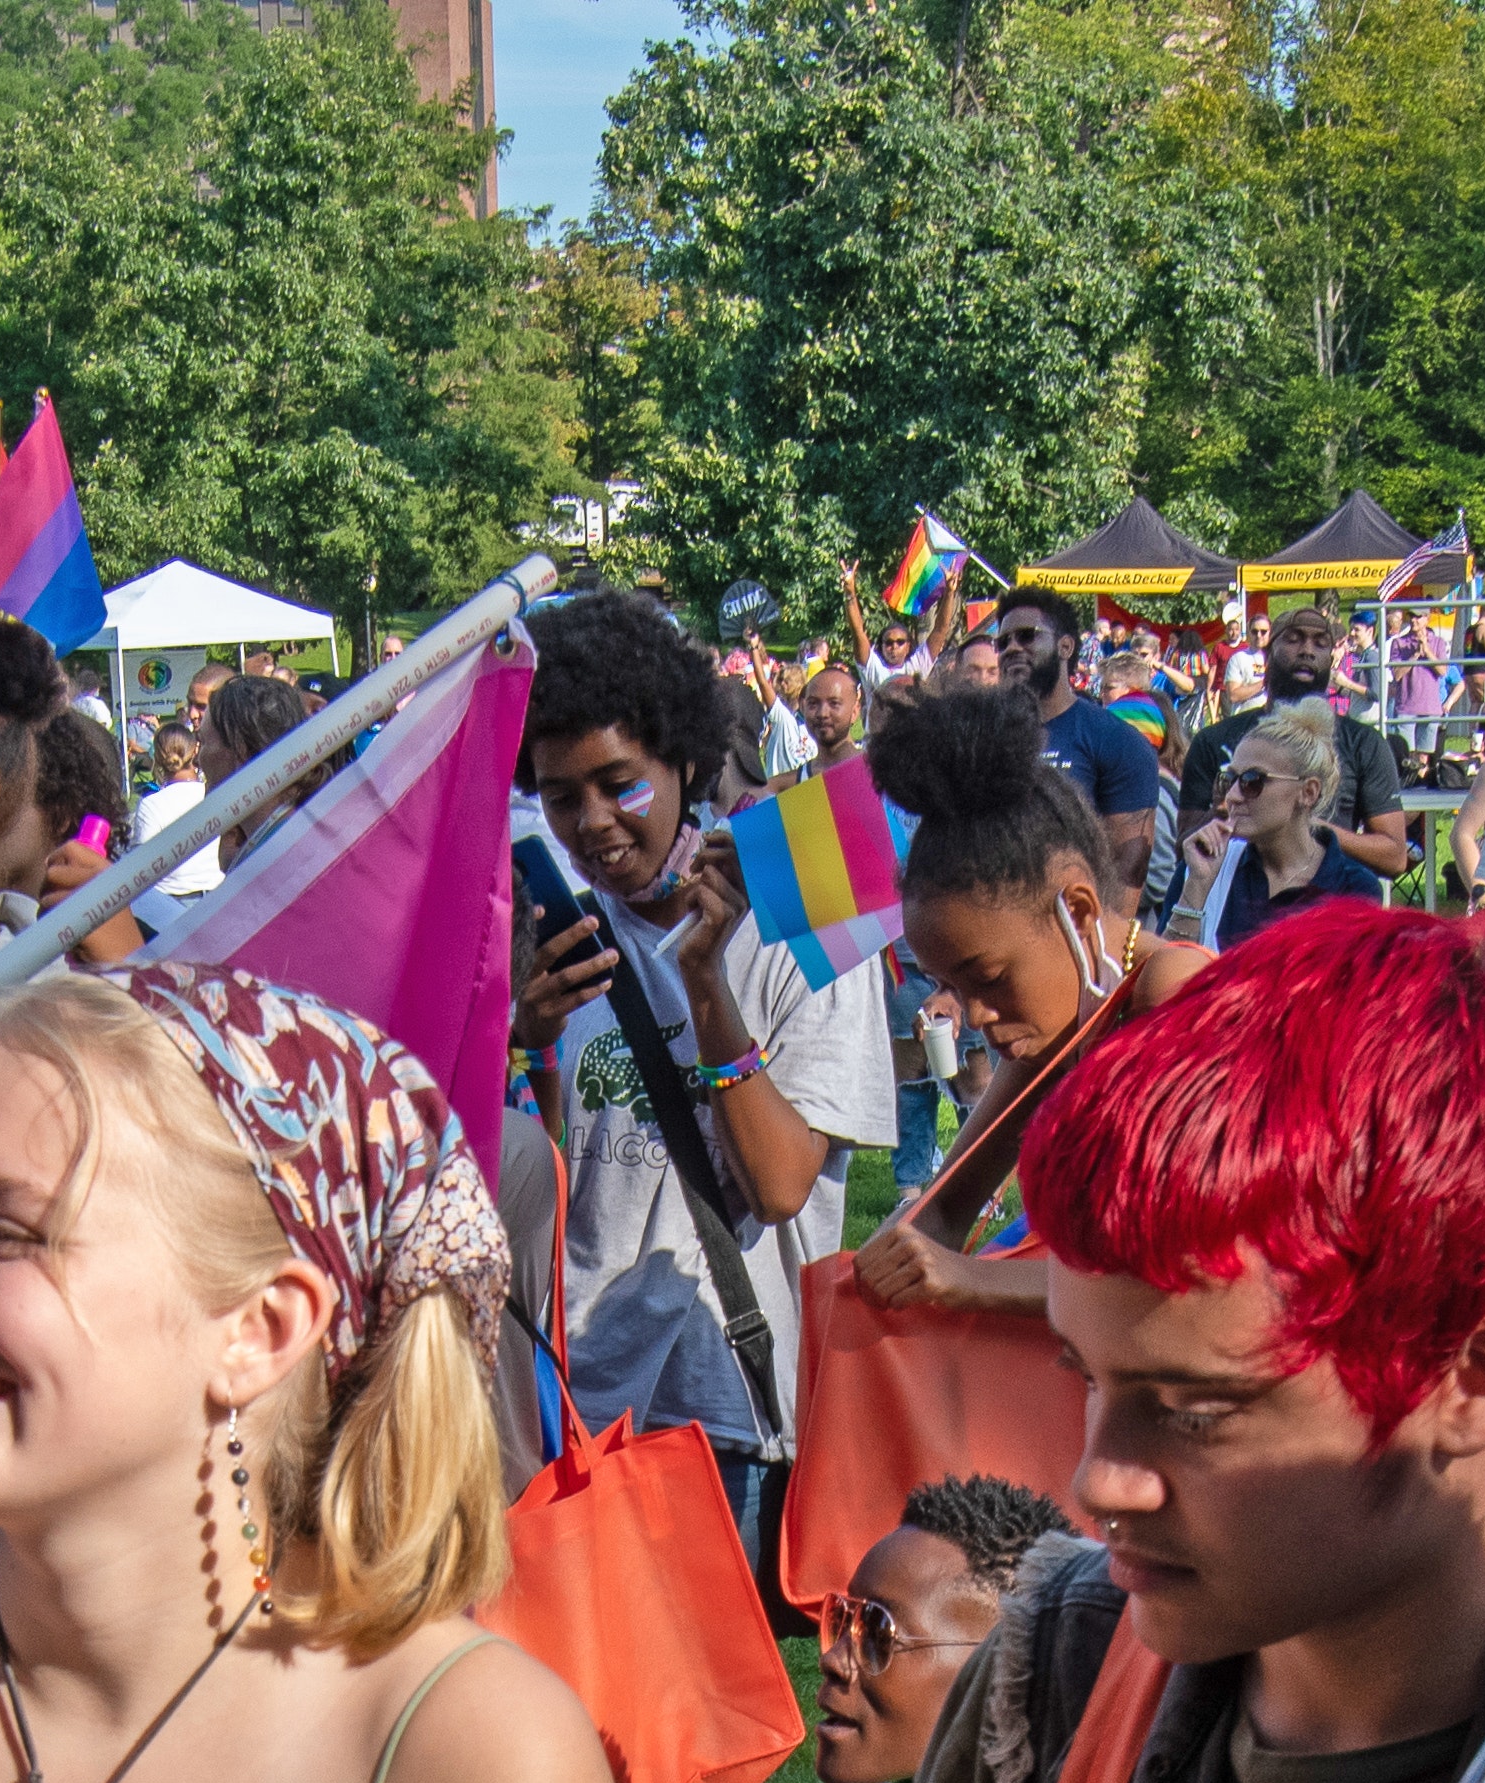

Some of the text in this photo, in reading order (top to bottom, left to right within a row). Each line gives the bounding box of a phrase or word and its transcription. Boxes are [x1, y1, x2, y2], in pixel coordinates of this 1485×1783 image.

[1036, 572, 1178, 586] StanleyBlack&Decker
[1261, 565, 1397, 582] StanleyBlack&Deck
[282, 750, 311, 775] MADE
[263, 772, 281, 789] IN
[169, 815, 222, 859] 02/01/21
